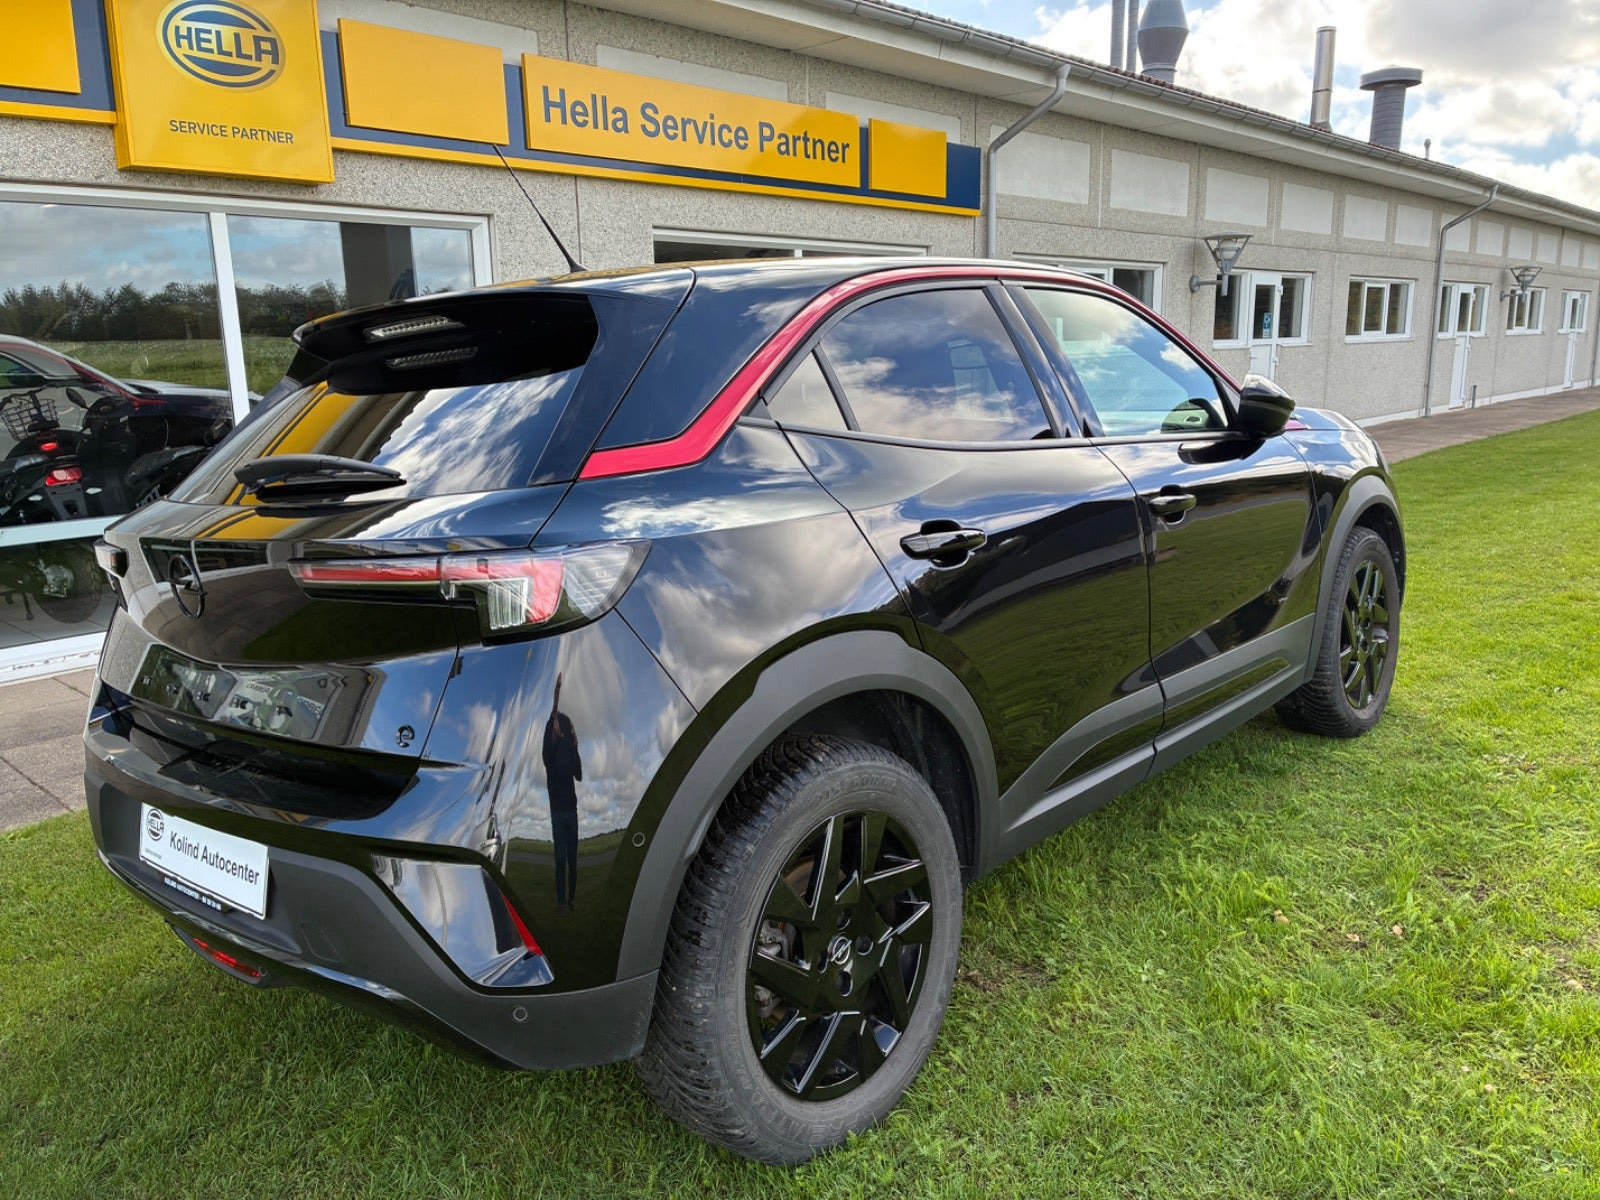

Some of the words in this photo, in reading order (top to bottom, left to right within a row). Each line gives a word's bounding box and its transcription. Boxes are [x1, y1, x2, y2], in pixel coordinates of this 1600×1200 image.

[174, 25, 280, 65] HELLA
[169, 119, 229, 138] SERVICE
[231, 126, 294, 144] PARTNER
[541, 84, 629, 134] Hella
[640, 101, 749, 151] Service
[759, 121, 850, 164] Partner
[169, 830, 200, 860] Kolind
[200, 845, 260, 886] Autocenter
